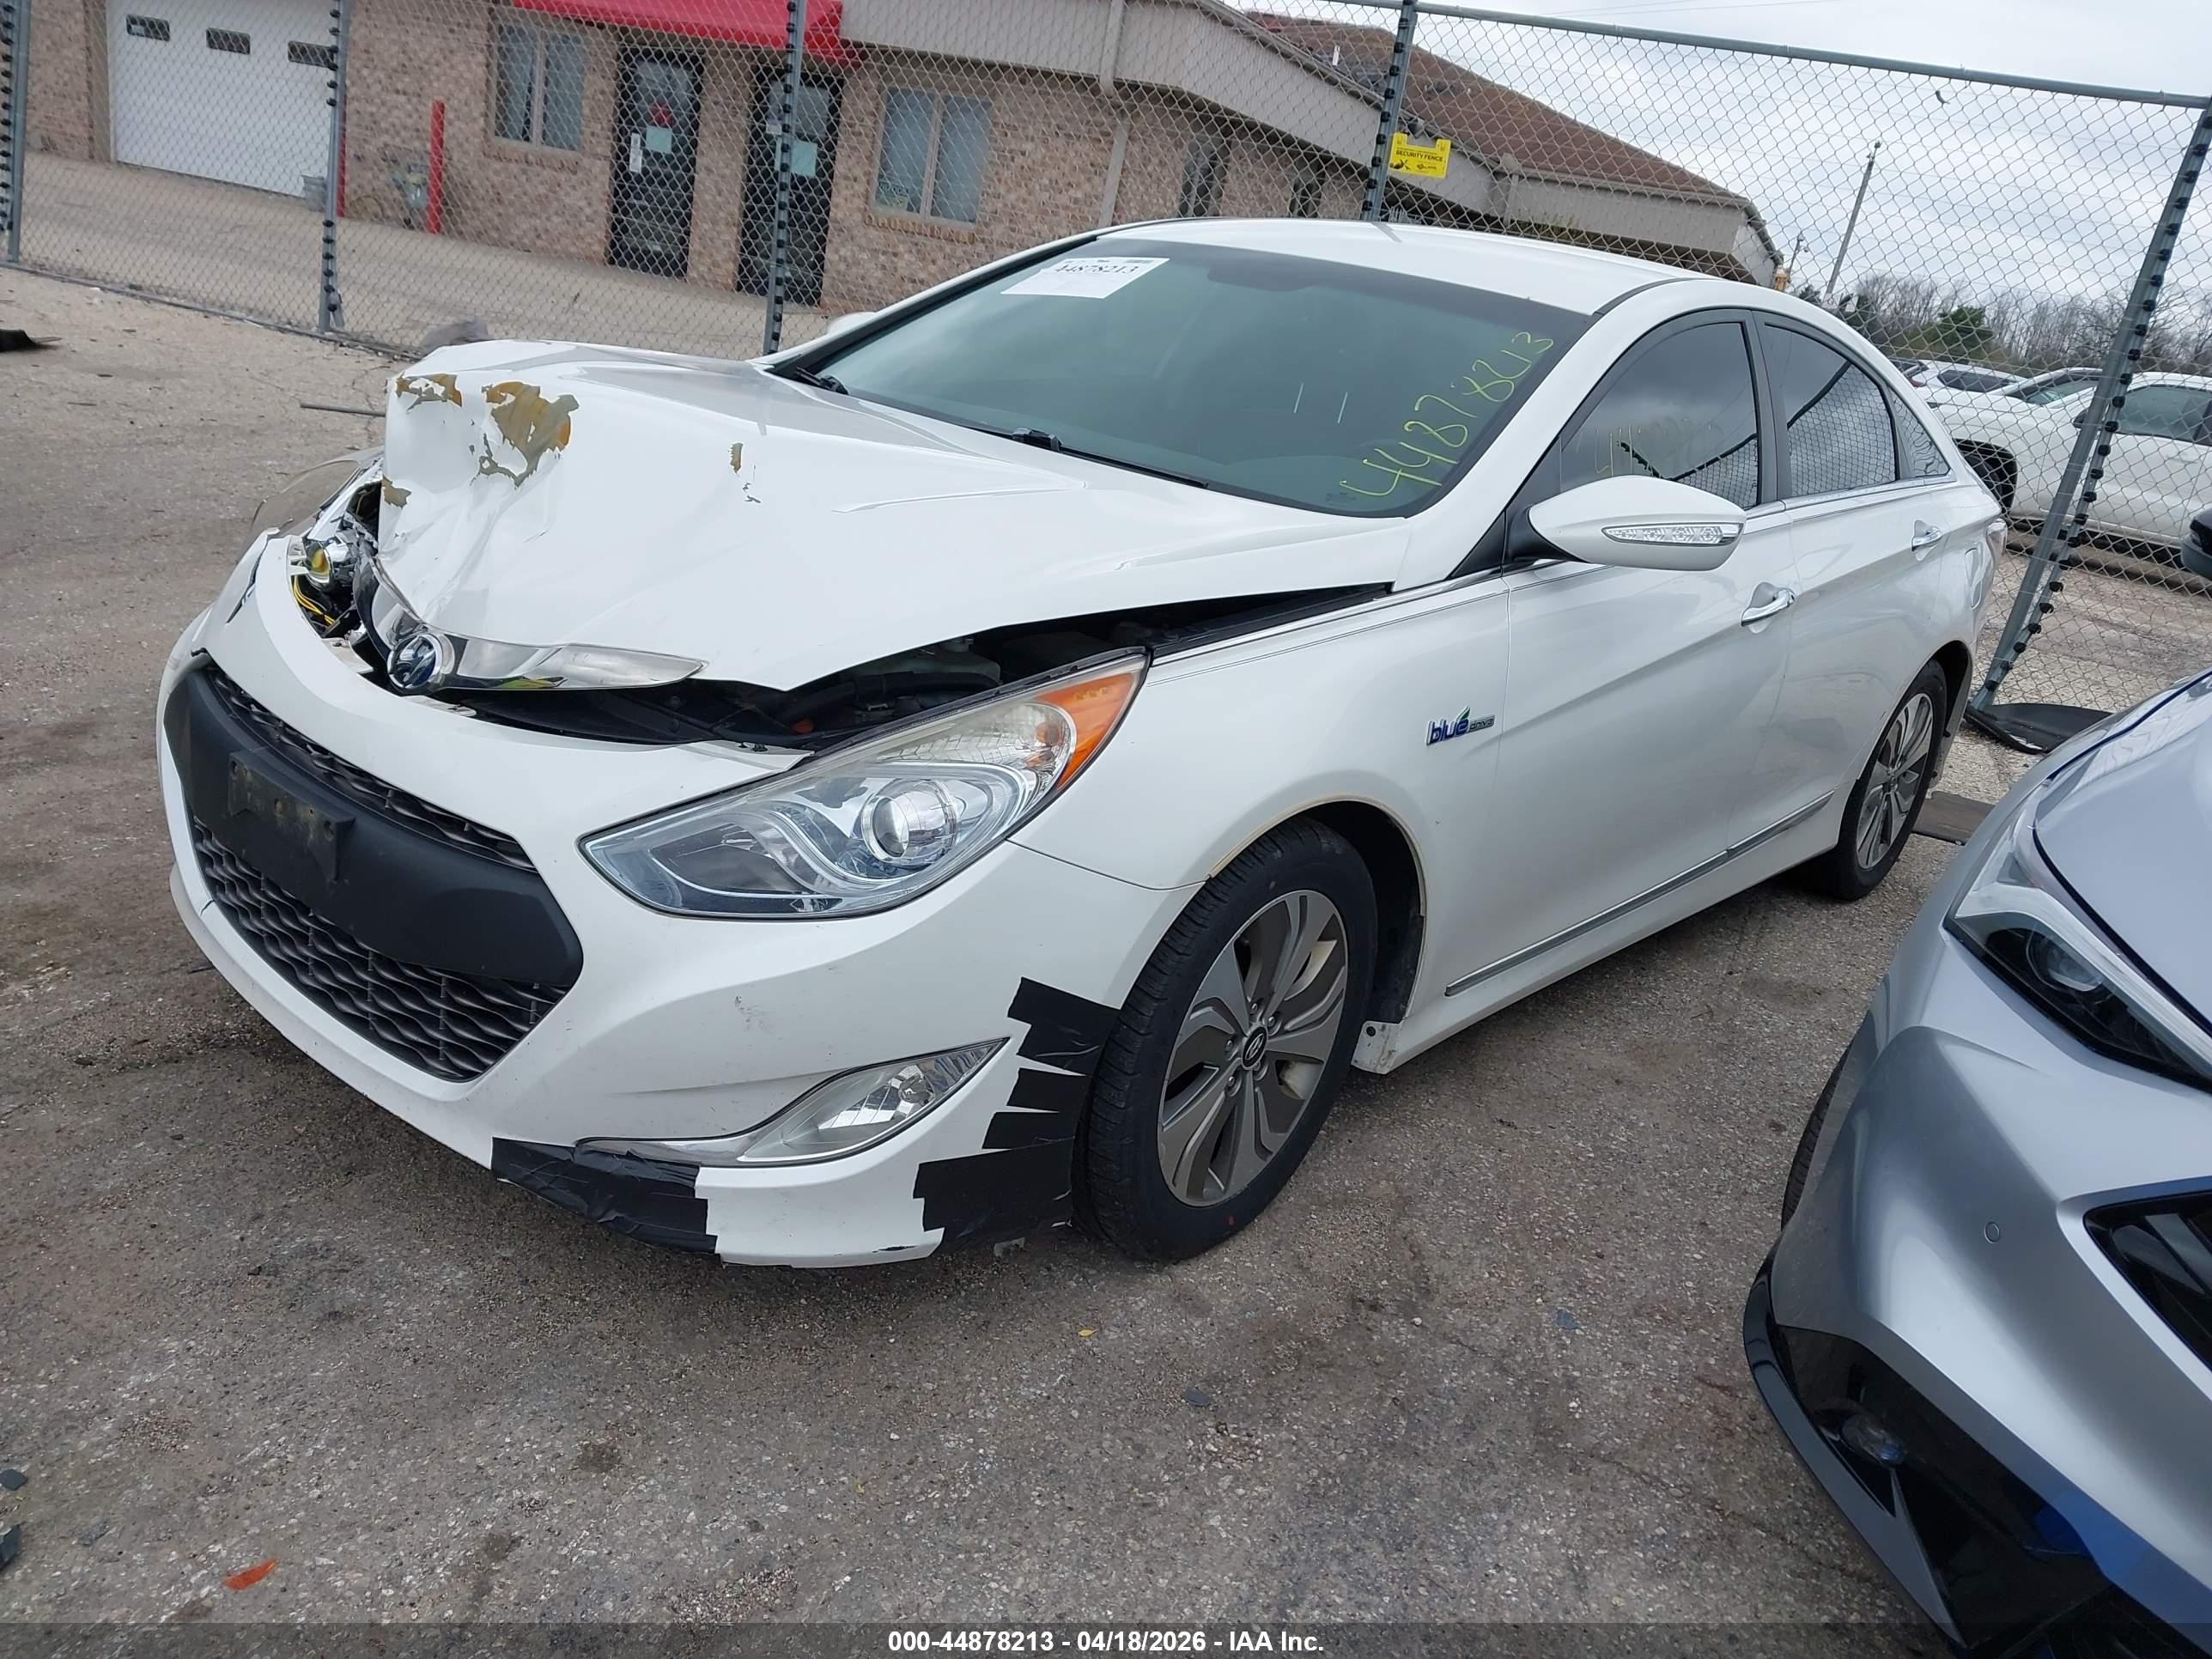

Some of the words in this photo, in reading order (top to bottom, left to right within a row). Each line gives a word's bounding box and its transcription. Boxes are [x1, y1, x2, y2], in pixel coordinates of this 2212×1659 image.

[1395, 149, 1425, 160] SECURITY
[1424, 154, 1443, 162] FENCE
[1426, 718, 1469, 745] blue
